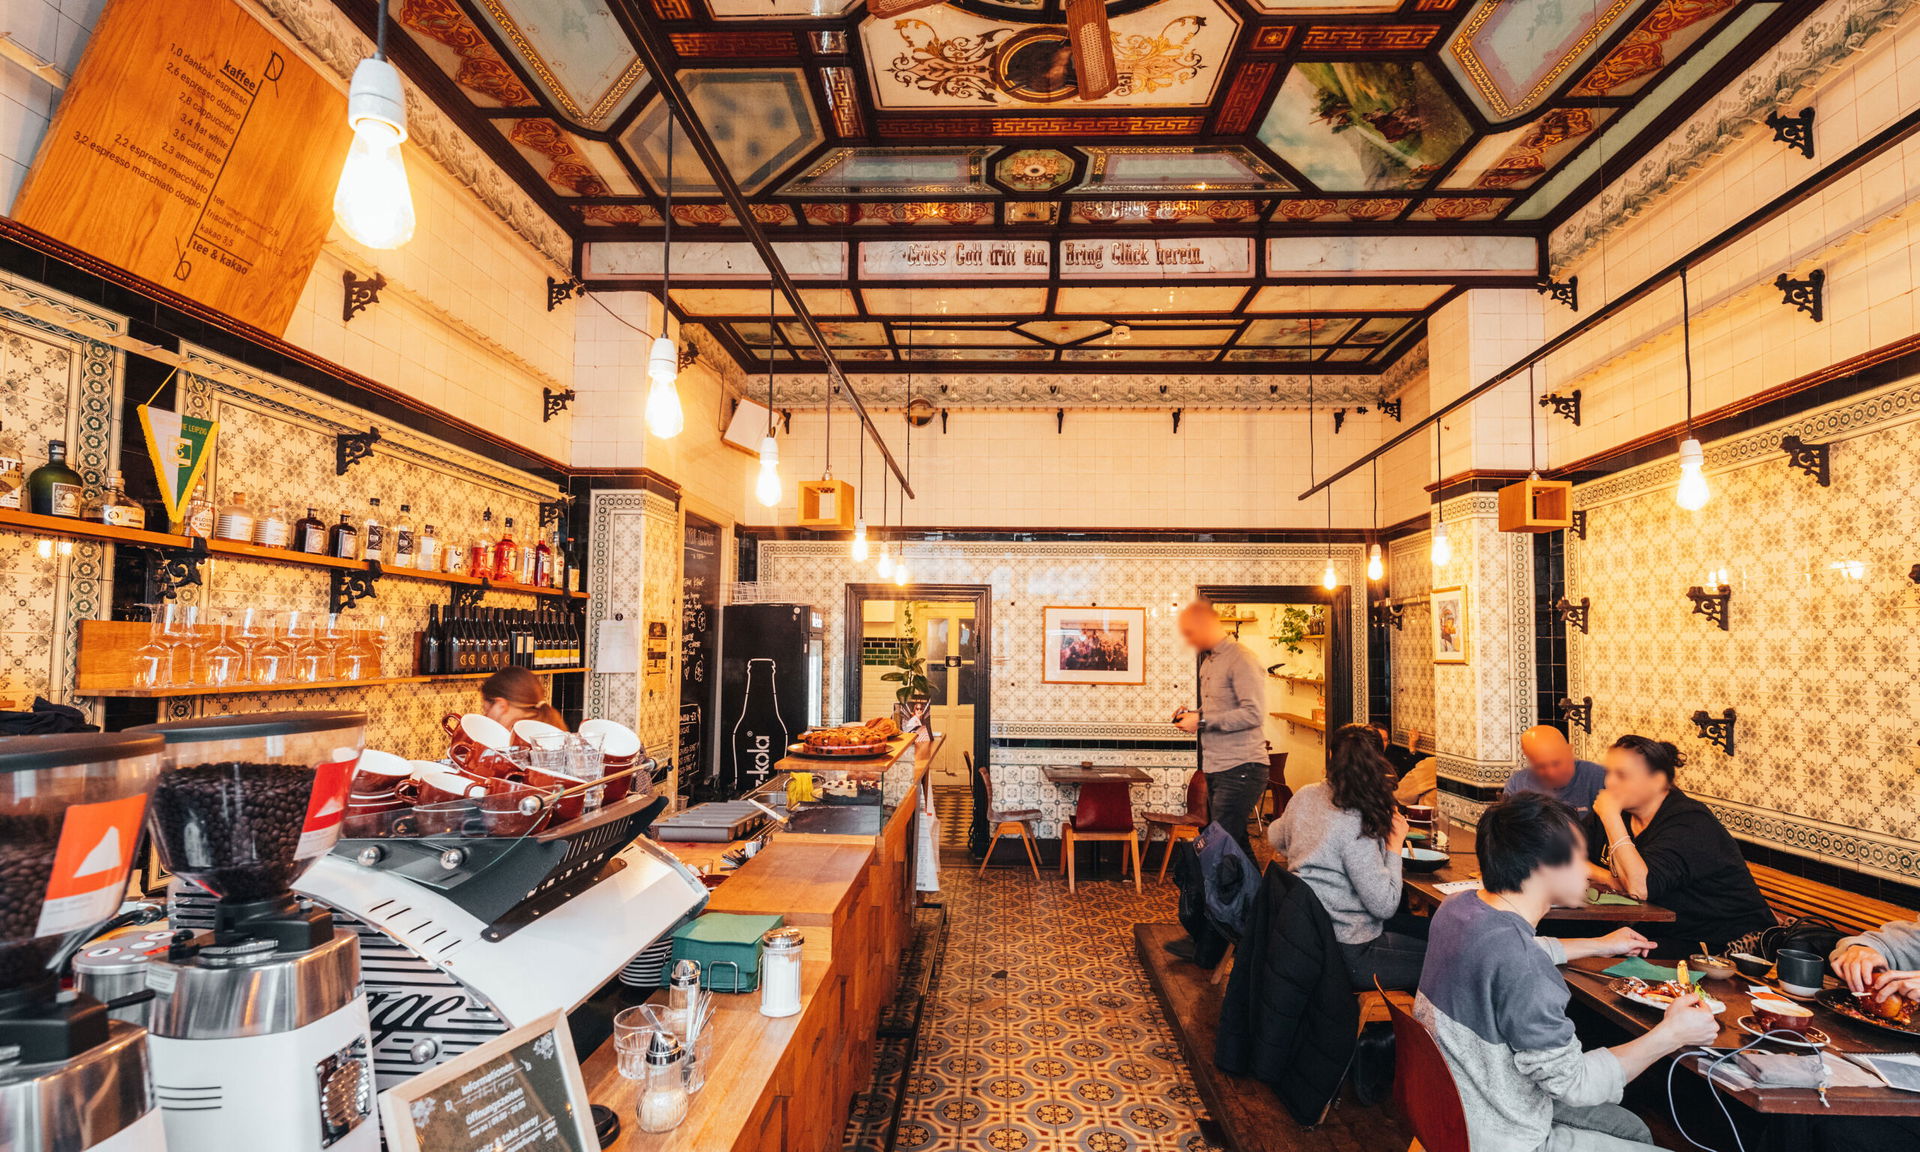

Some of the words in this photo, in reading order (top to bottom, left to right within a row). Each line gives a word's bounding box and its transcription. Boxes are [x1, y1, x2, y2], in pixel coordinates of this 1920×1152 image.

[183, 54, 215, 81] dankbar
[215, 78, 248, 105] espresso
[223, 59, 256, 91] kaffee
[180, 73, 215, 102] espresso
[216, 97, 241, 120] doppio
[192, 102, 235, 135] cappuccino
[194, 121, 207, 136] flat
[208, 132, 228, 150] white
[175, 151, 215, 180] americano
[186, 138, 204, 153] café
[204, 149, 221, 164] latte
[90, 141, 130, 169] espresso
[131, 165, 174, 194] macchiato
[175, 189, 201, 209] doppio
[129, 143, 168, 170] espresso
[168, 166, 208, 194] macchiato
[213, 195, 225, 207] tee
[200, 224, 221, 240] kakao
[206, 208, 233, 229] frischer
[234, 224, 246, 237] tee
[192, 240, 209, 255] tee
[210, 249, 218, 260] &
[219, 253, 248, 275] kakao
[955, 242, 982, 266] Gott
[1065, 243, 1104, 269] Bring
[1111, 242, 1149, 265] Glück
